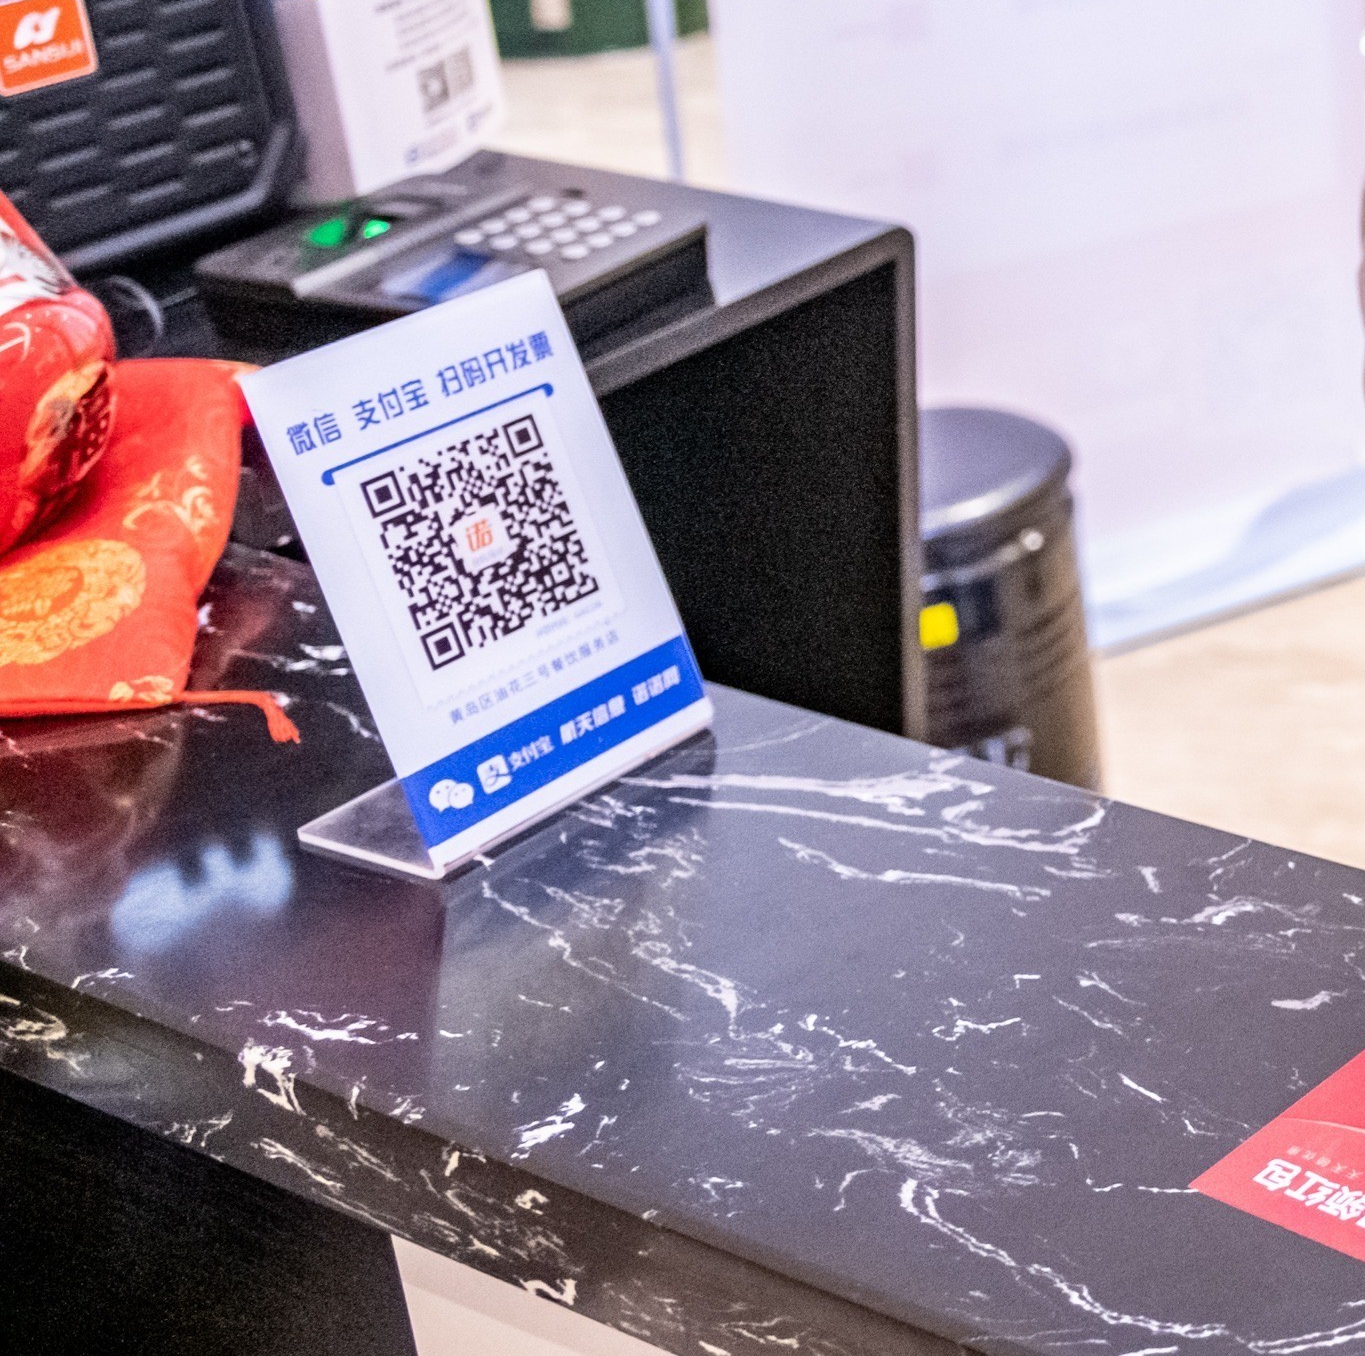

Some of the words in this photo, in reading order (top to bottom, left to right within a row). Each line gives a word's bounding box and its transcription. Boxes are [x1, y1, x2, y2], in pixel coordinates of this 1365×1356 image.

[286, 412, 342, 456] 微信
[352, 378, 430, 431] 支付宝
[436, 330, 555, 398] 扫码开发票
